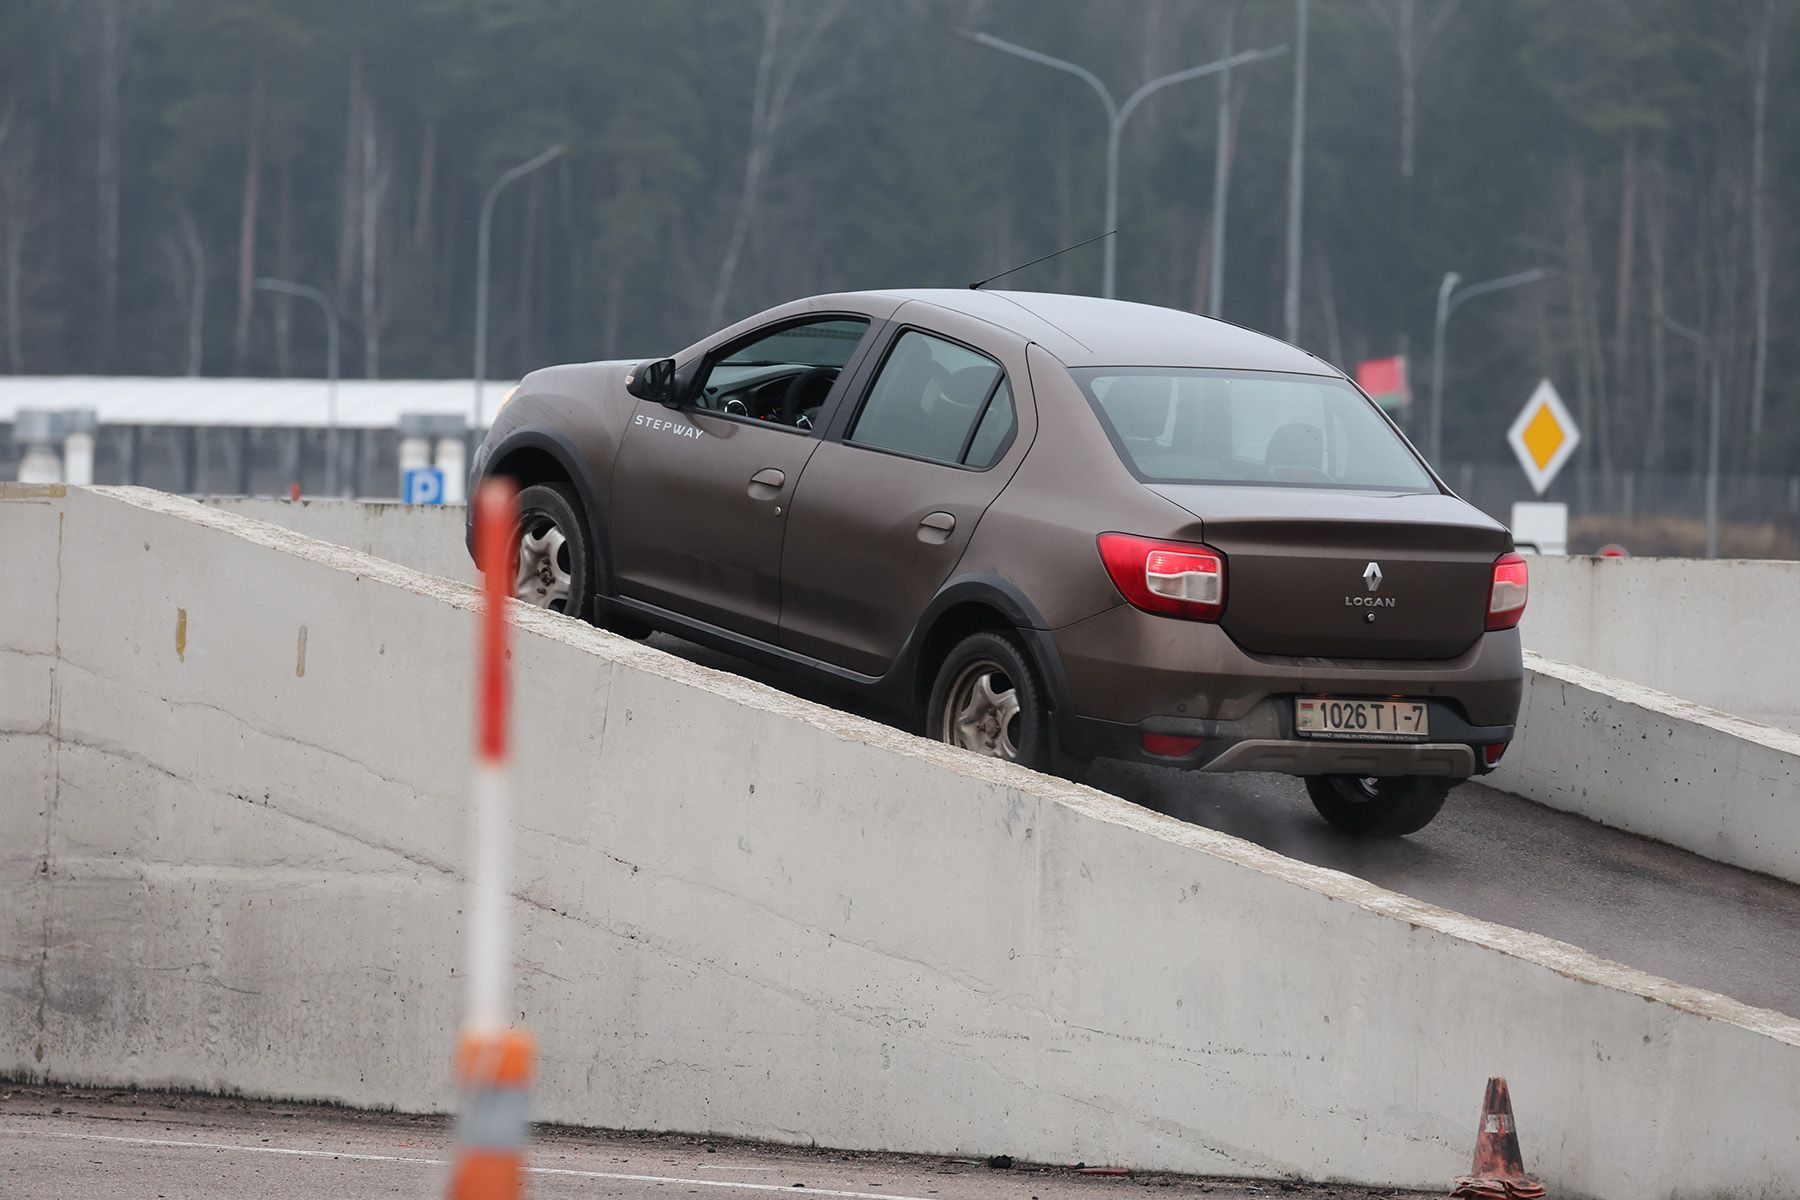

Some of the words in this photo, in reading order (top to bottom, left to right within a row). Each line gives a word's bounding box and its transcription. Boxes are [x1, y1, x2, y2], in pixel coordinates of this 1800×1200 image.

[635, 414, 704, 439] STEPWAY
[412, 470, 439, 504] P
[1345, 596, 1396, 608] LOGAN
